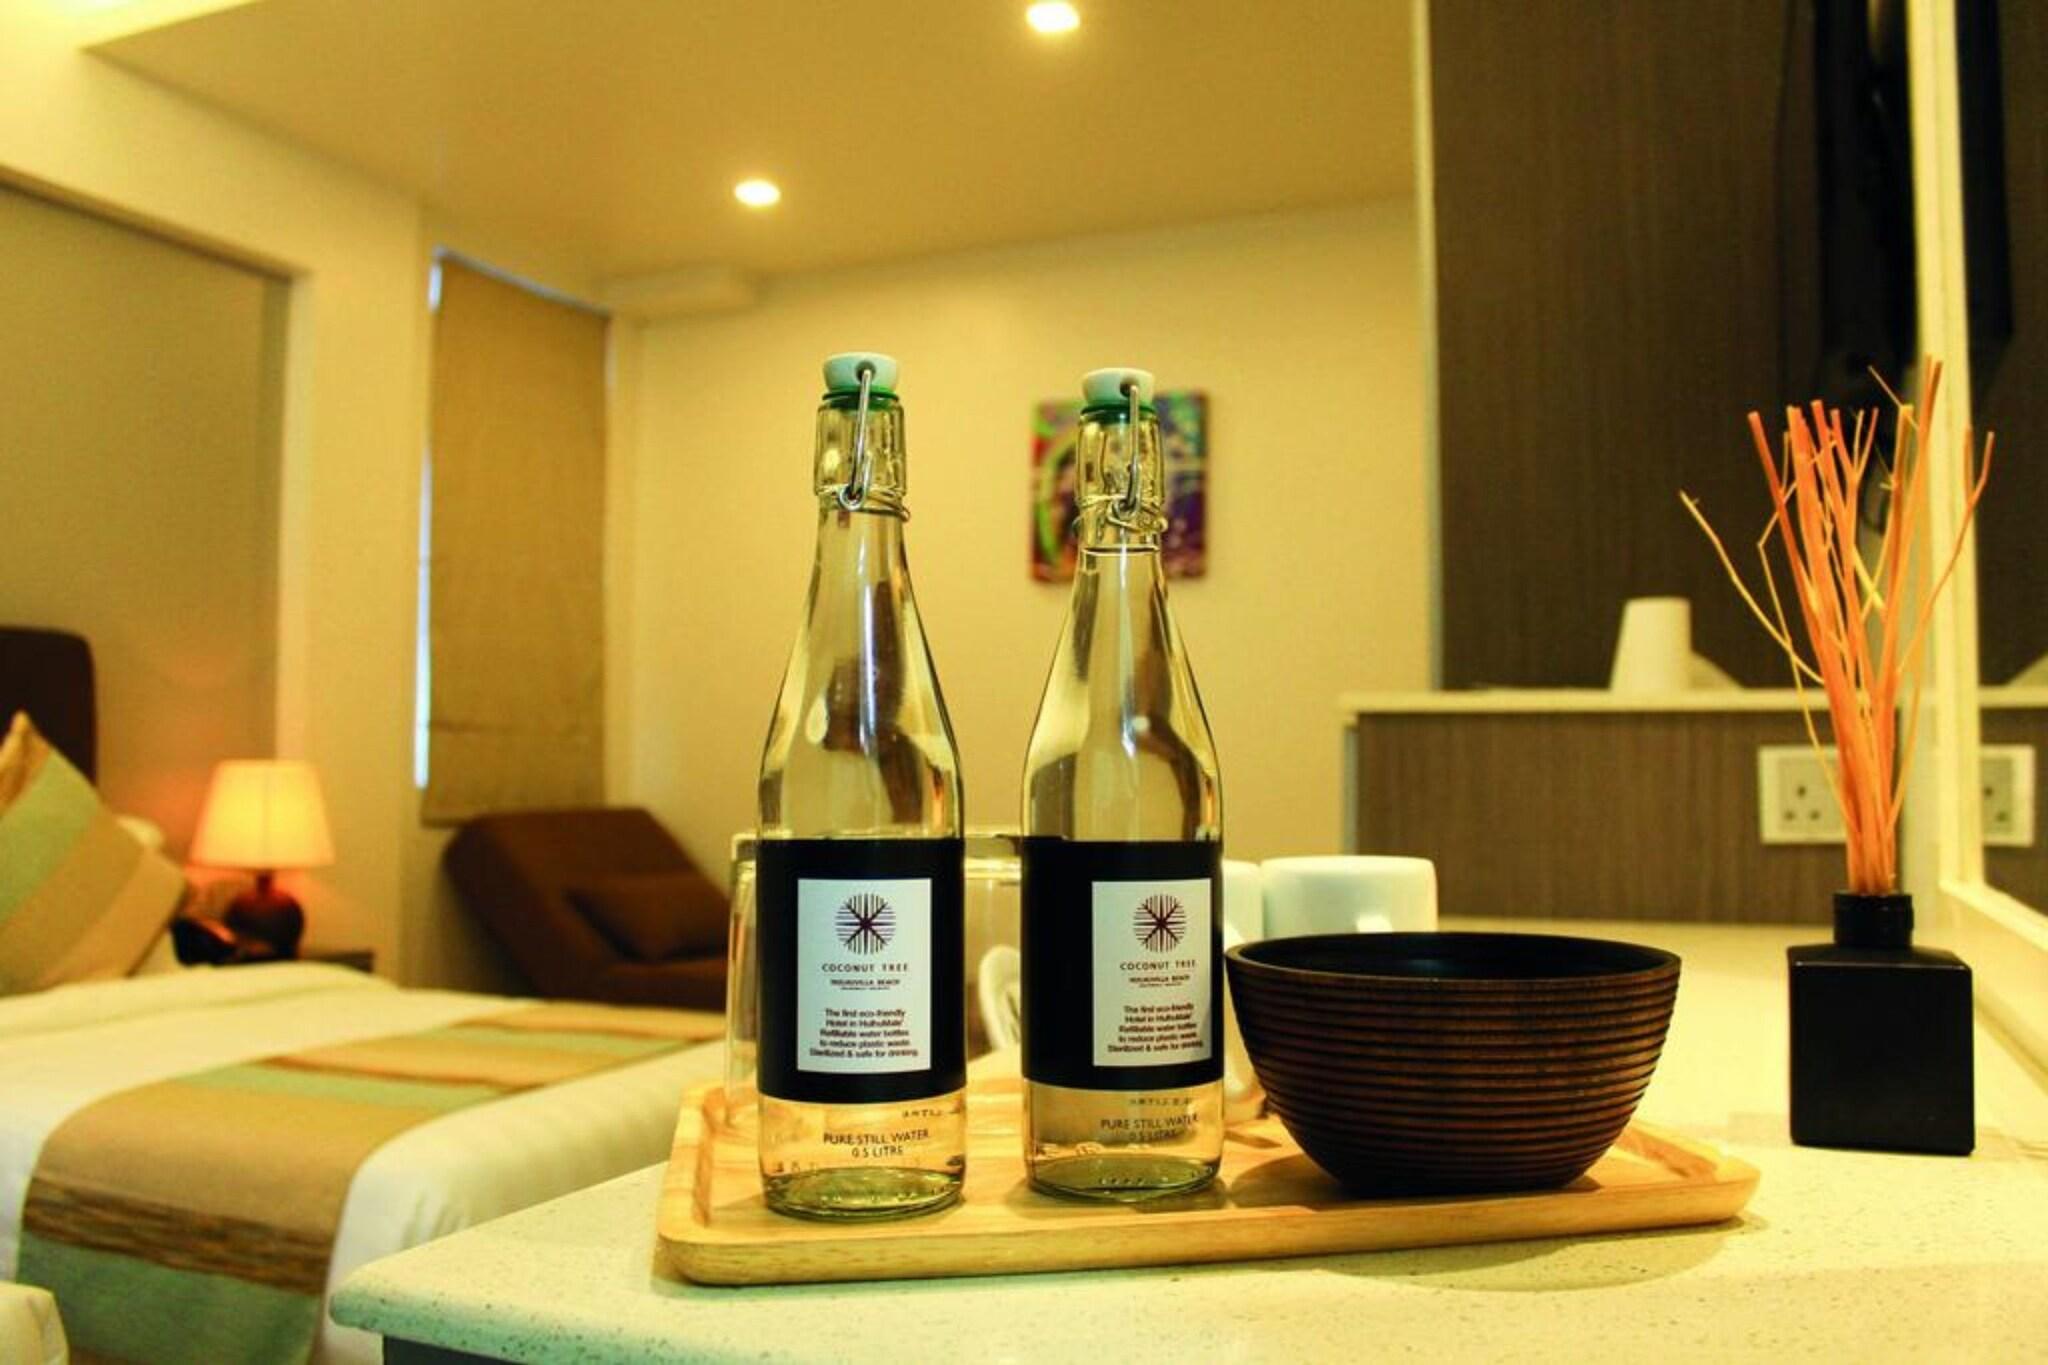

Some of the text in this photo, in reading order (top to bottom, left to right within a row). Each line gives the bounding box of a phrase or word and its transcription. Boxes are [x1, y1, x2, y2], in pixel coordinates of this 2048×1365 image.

[821, 963, 907, 972] COCONUT TREE
[1120, 961, 1169, 971] COCONUT
[825, 1008, 840, 1017] The
[825, 1019, 848, 1027] Hotel
[859, 1040, 884, 1049] plastic
[1153, 1044, 1168, 1052] safe
[847, 1049, 853, 1057] &
[855, 1049, 873, 1058] safe
[875, 1049, 886, 1057] for
[1101, 1118, 1129, 1130] PURE
[1134, 1118, 1162, 1129] STILL
[823, 1129, 929, 1146] PURE STILL WATER
[873, 1146, 903, 1158] LITRE
